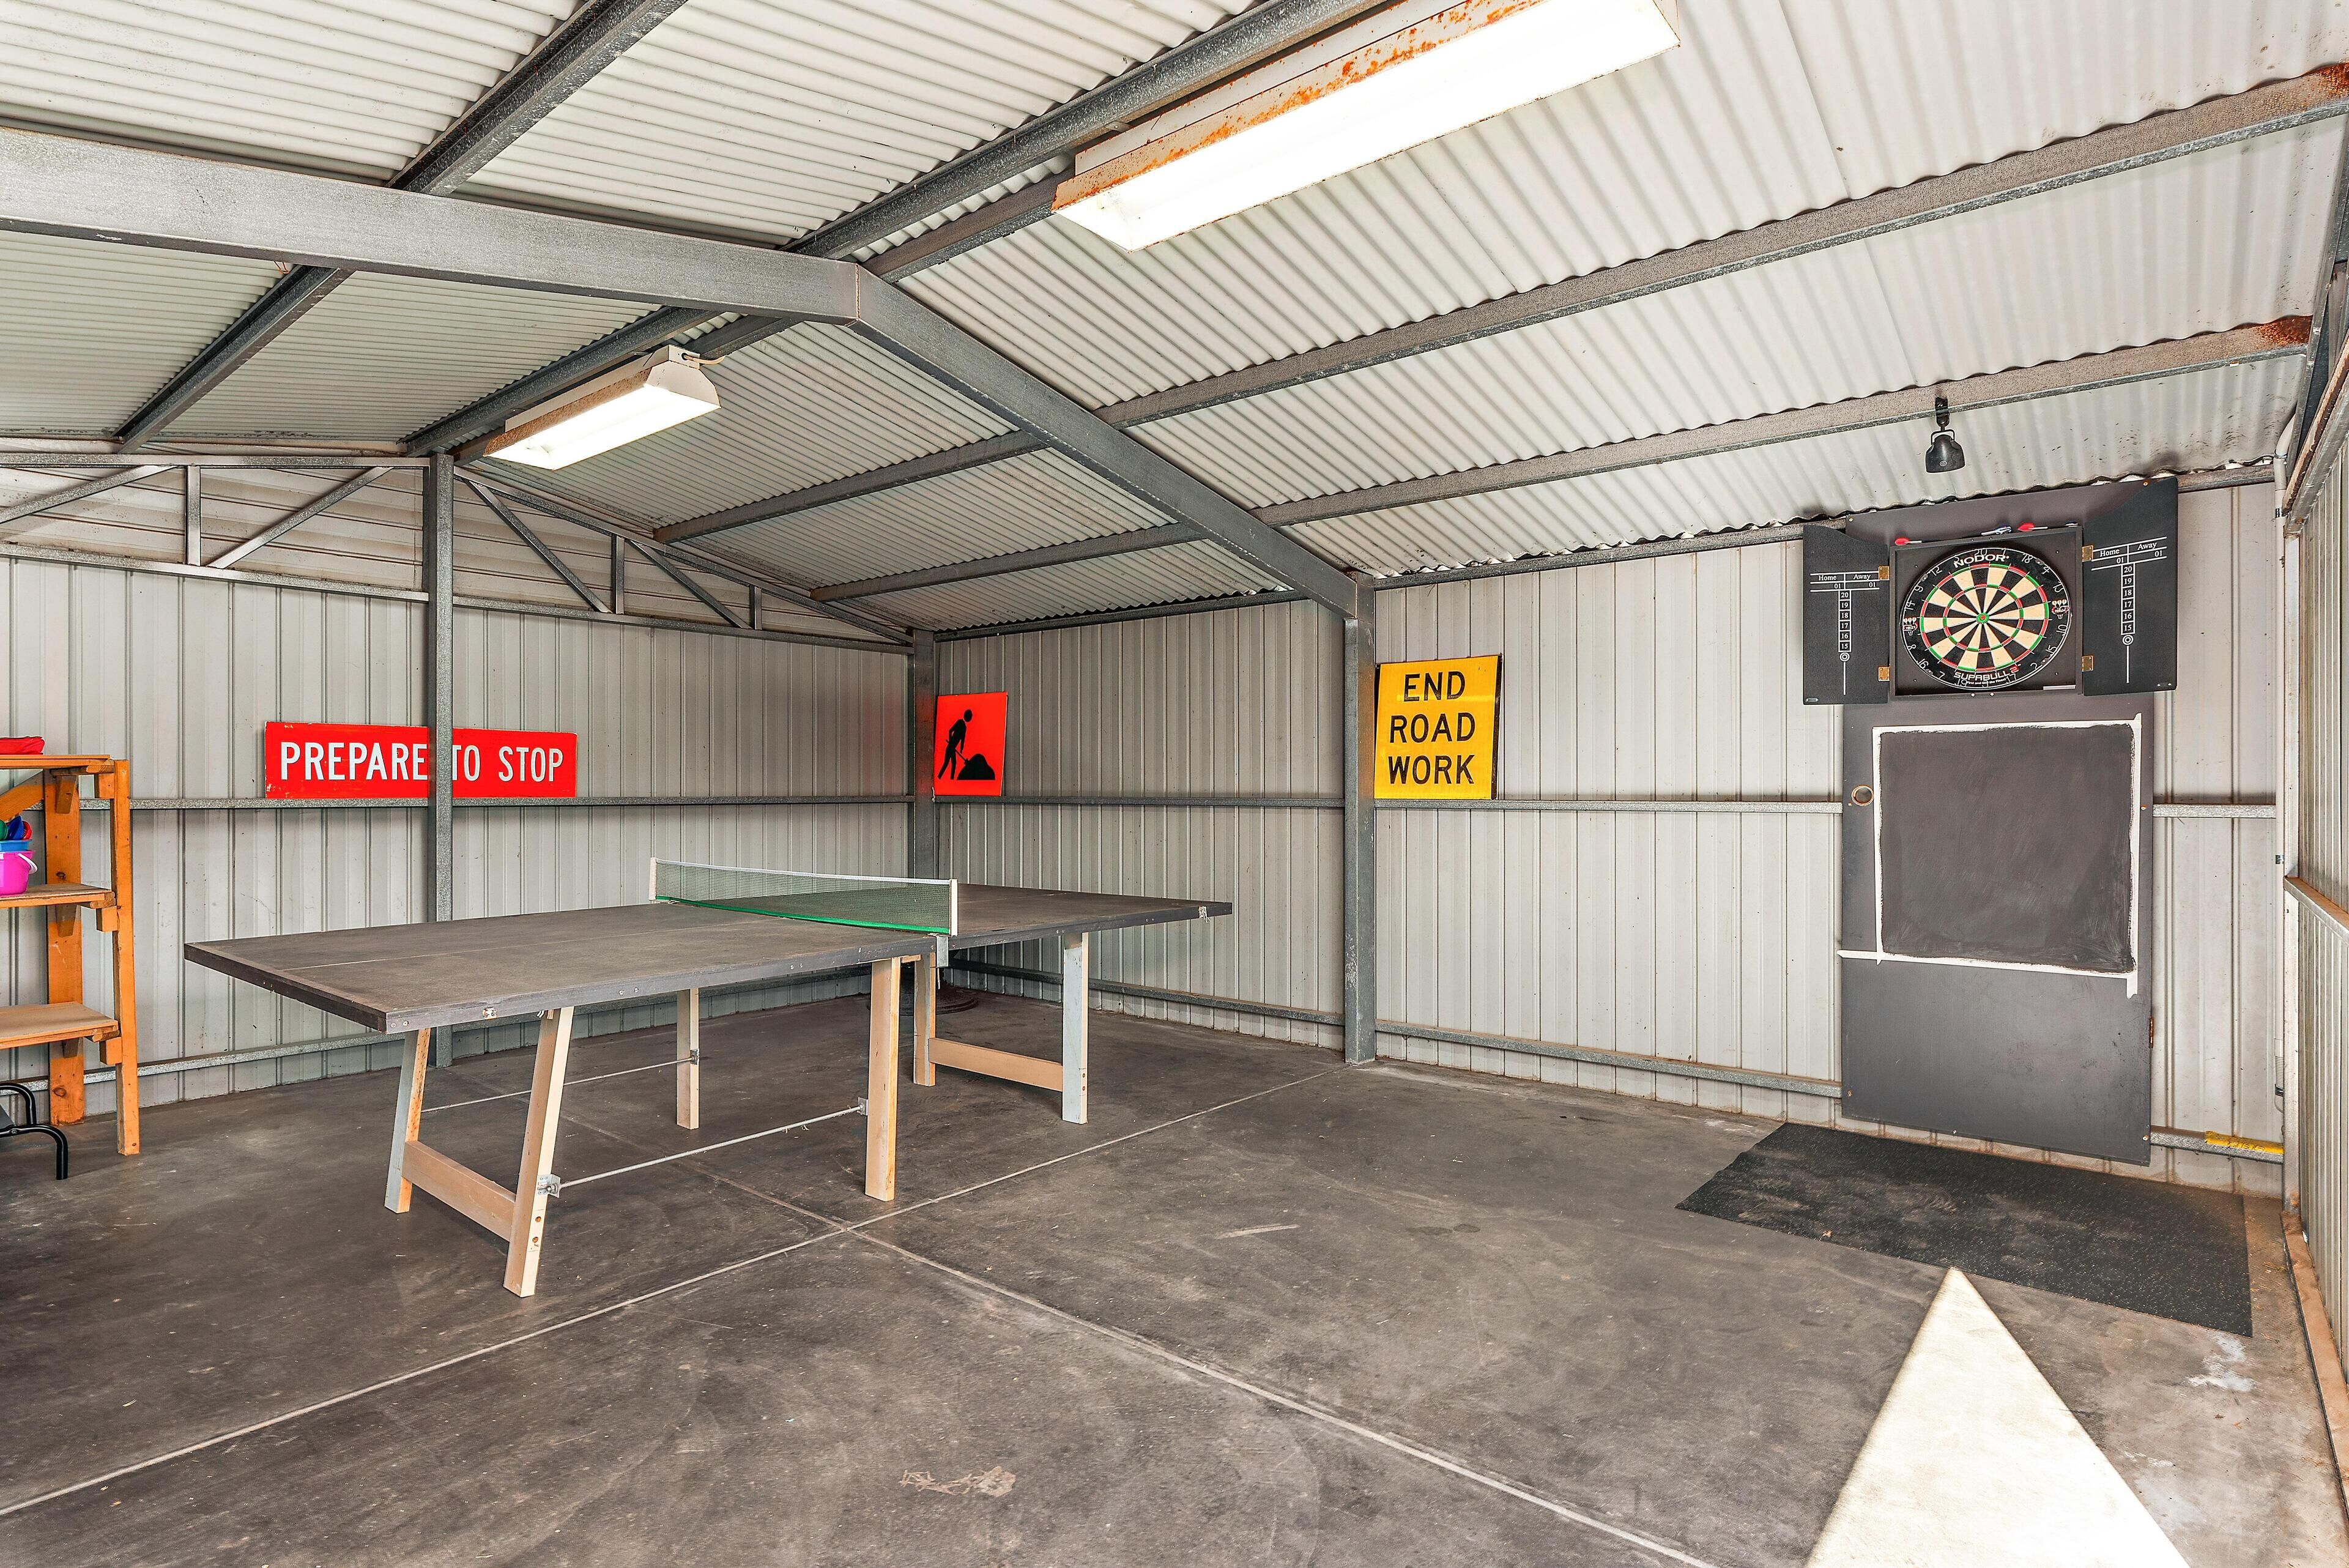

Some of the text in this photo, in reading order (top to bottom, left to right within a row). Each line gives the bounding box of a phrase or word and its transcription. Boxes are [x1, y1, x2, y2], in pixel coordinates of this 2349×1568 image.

[2099, 542, 2158, 557] Home Away
[1953, 554, 2006, 568] NODOR
[2022, 553, 2033, 563] 18
[1928, 566, 1943, 576] 12
[1904, 600, 1915, 610] 14
[2046, 644, 2058, 656] 15
[1917, 658, 1929, 669] 16
[1938, 671, 1945, 679] 7
[1953, 671, 2010, 681] SUPABULL
[1404, 671, 1466, 702] END
[1390, 712, 1475, 743] ROAD
[281, 741, 563, 782] PREPARE TO STOP
[1388, 754, 1475, 784] WORK
